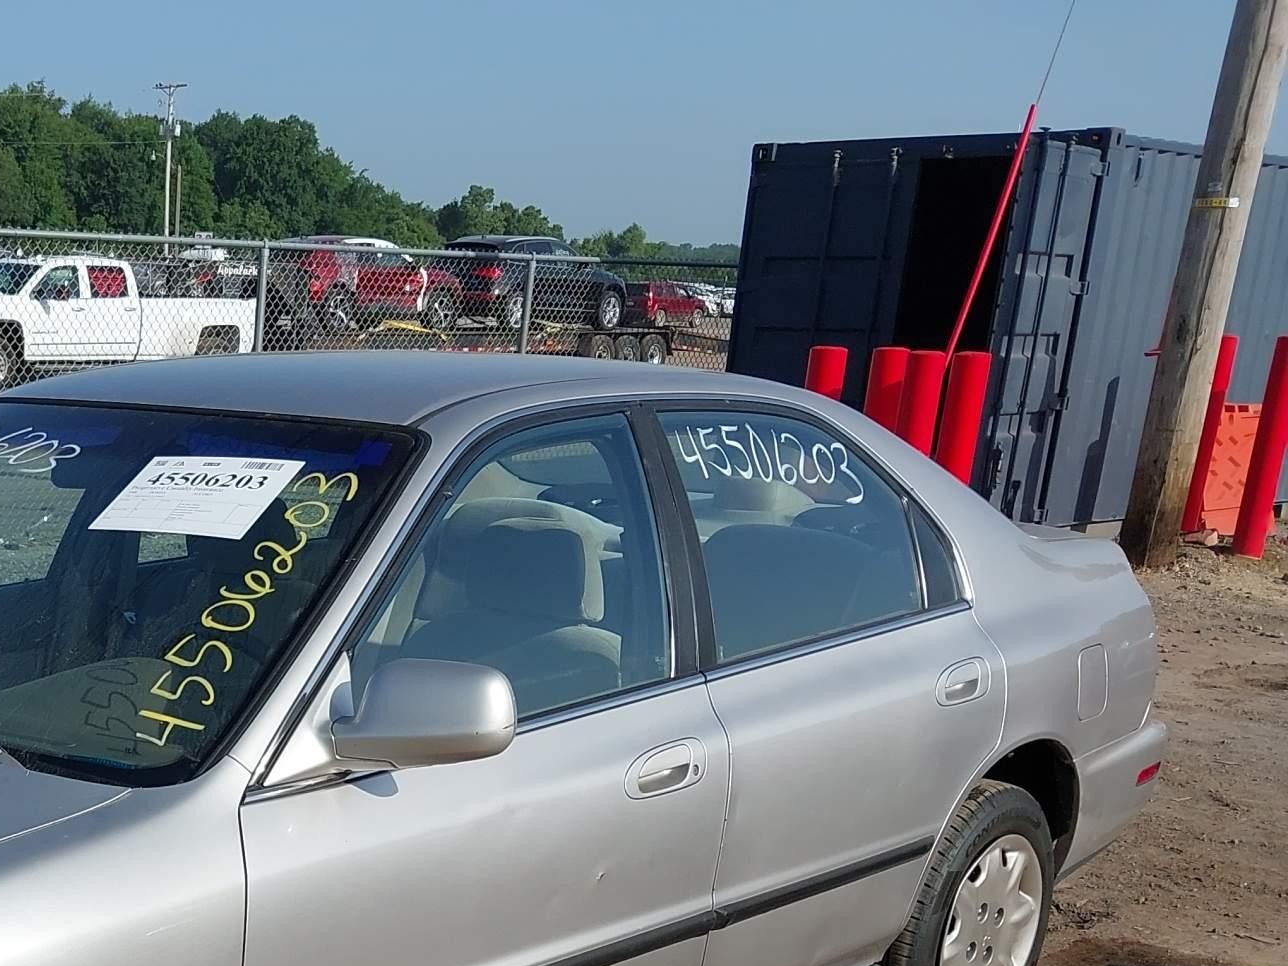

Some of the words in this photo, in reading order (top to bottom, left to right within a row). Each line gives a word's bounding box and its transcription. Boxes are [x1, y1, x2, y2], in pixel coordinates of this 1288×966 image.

[146, 471, 270, 490] 45506203
[675, 423, 865, 505] 45506203
[135, 471, 359, 748] 45506203
